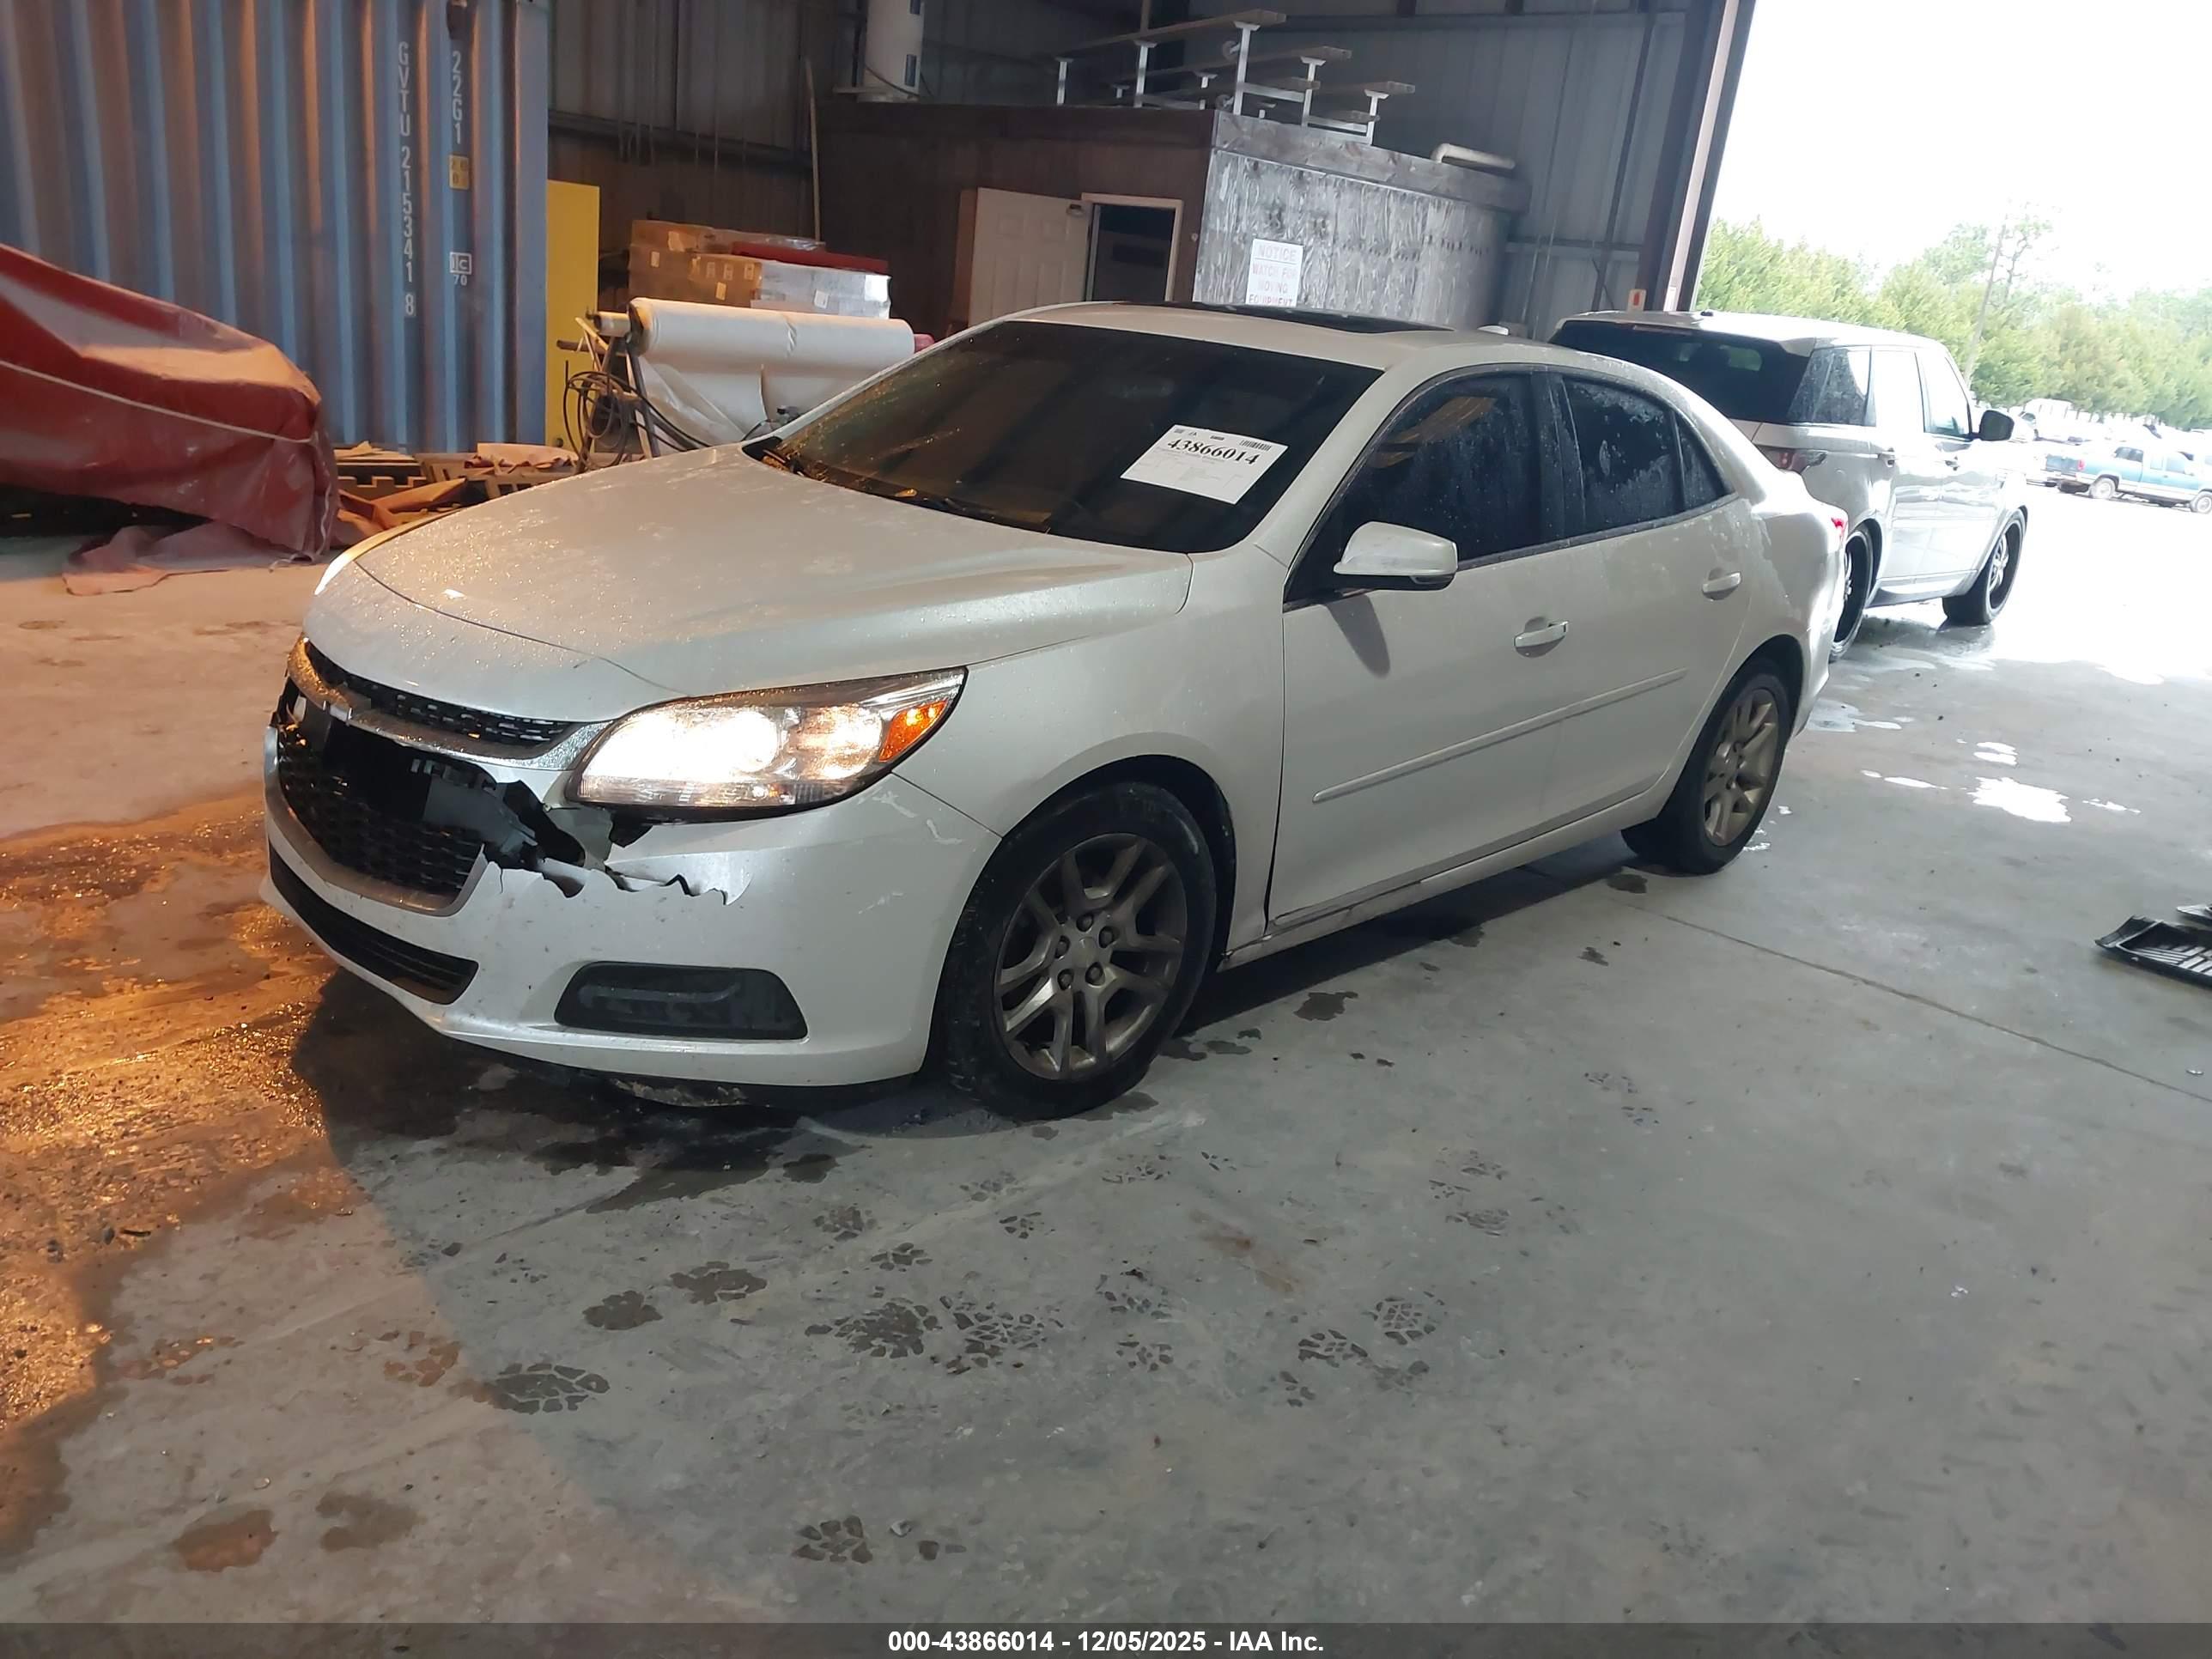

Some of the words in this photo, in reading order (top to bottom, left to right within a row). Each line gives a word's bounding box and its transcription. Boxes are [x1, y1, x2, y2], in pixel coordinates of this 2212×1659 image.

[398, 40, 410, 137] GVTU
[453, 50, 463, 145] 22G1
[401, 145, 413, 283] 215341
[1258, 244, 1297, 262] NOTICE
[453, 274, 468, 286] 70
[1257, 280, 1288, 295] MONG
[404, 294, 415, 317] 8
[1167, 438, 1261, 465] 43866014
